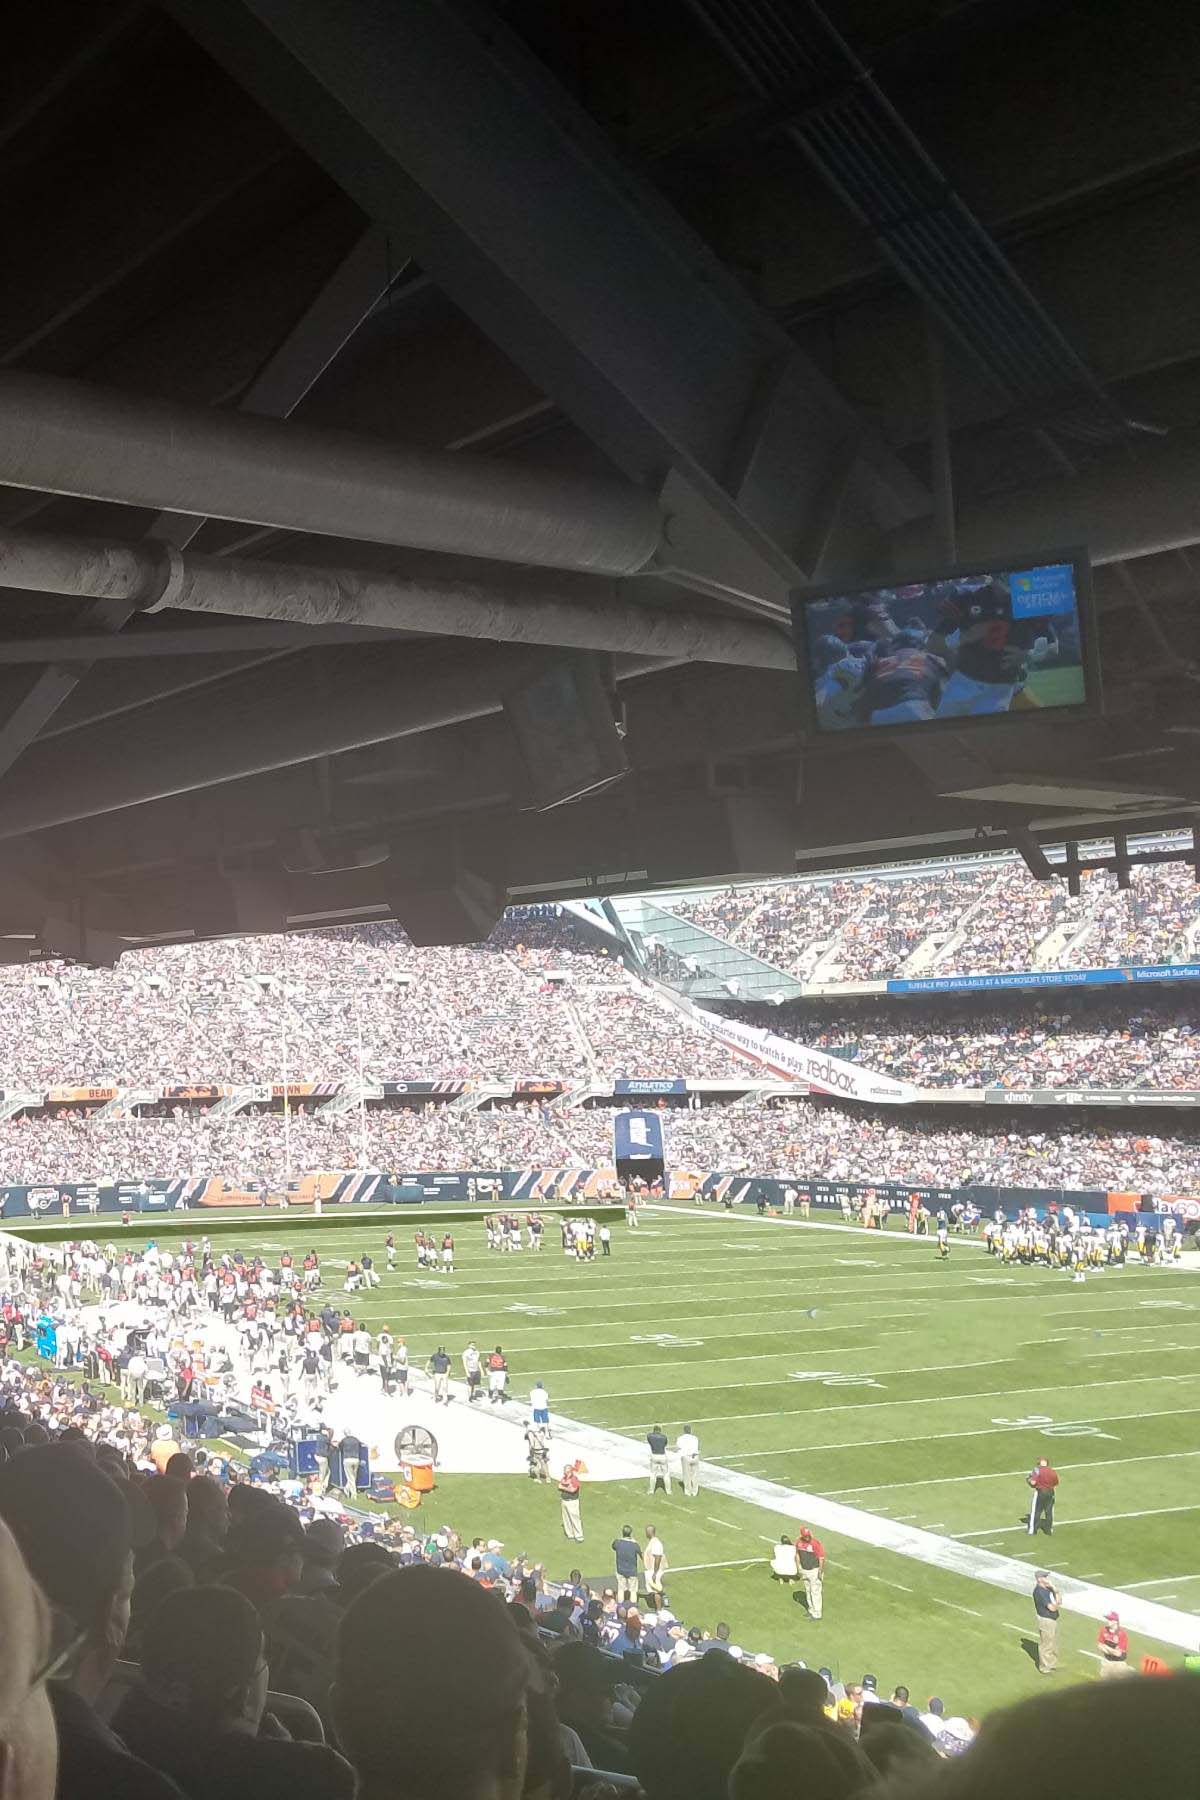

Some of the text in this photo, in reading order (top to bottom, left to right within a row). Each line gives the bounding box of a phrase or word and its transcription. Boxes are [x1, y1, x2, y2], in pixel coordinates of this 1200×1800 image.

[1136, 968, 1200, 978] Microsoft Surface
[1041, 975, 1062, 983] STORE
[1064, 974, 1087, 982] TODAY
[88, 1088, 113, 1098] BEAR
[272, 1084, 301, 1095] DOWN
[991, 1414, 1102, 1437] 30
[1144, 1658, 1158, 1672] 10
